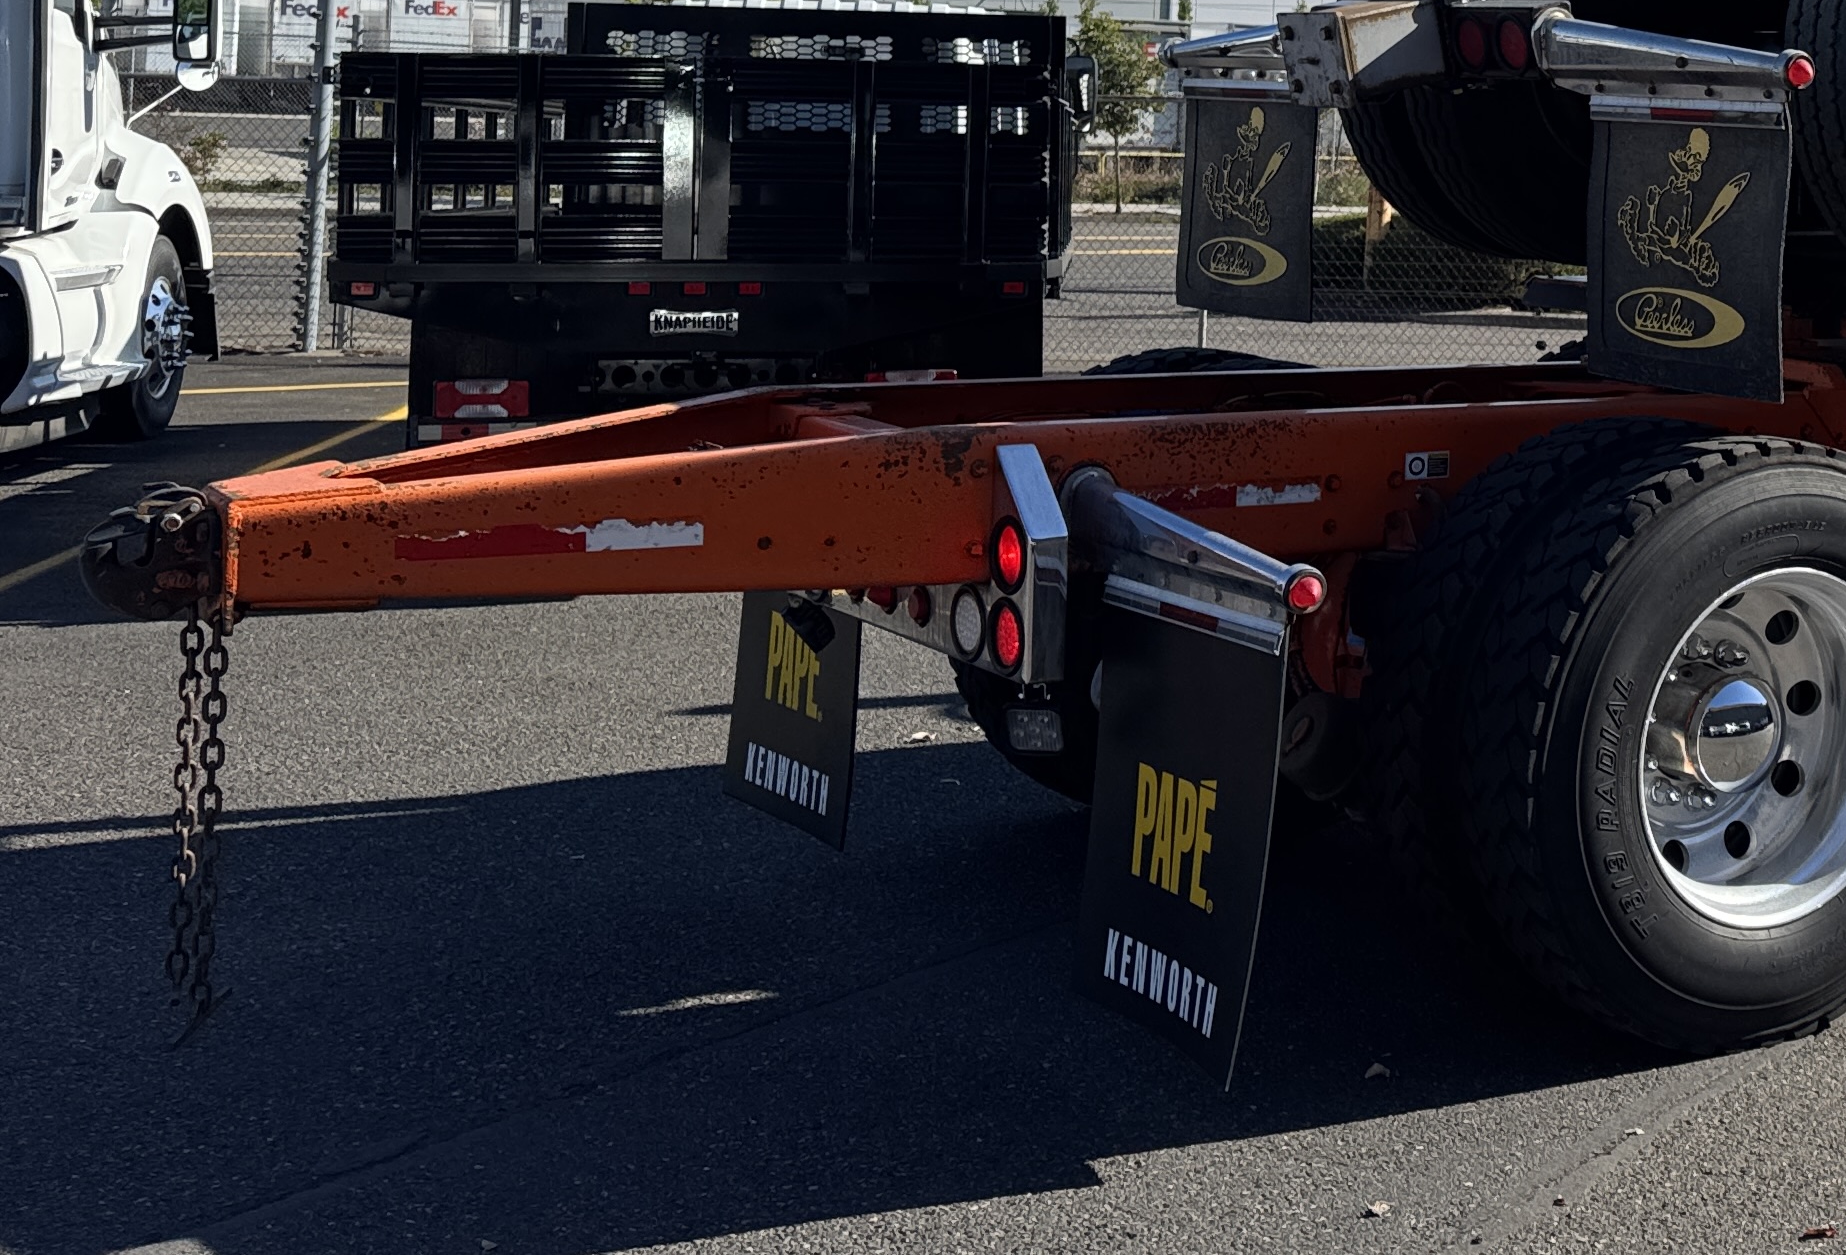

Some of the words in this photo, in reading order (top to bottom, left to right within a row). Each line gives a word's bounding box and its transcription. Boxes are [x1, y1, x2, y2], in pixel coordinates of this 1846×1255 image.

[404, 0, 458, 17] FedEx
[653, 312, 735, 332] KNAPHEIDE
[1634, 293, 1695, 337] Peerless
[744, 741, 829, 817] KENWORTH
[1594, 671, 1635, 832] RADIAL
[1131, 761, 1218, 910] PAPÉ
[1103, 927, 1218, 1039] KENWORTH
